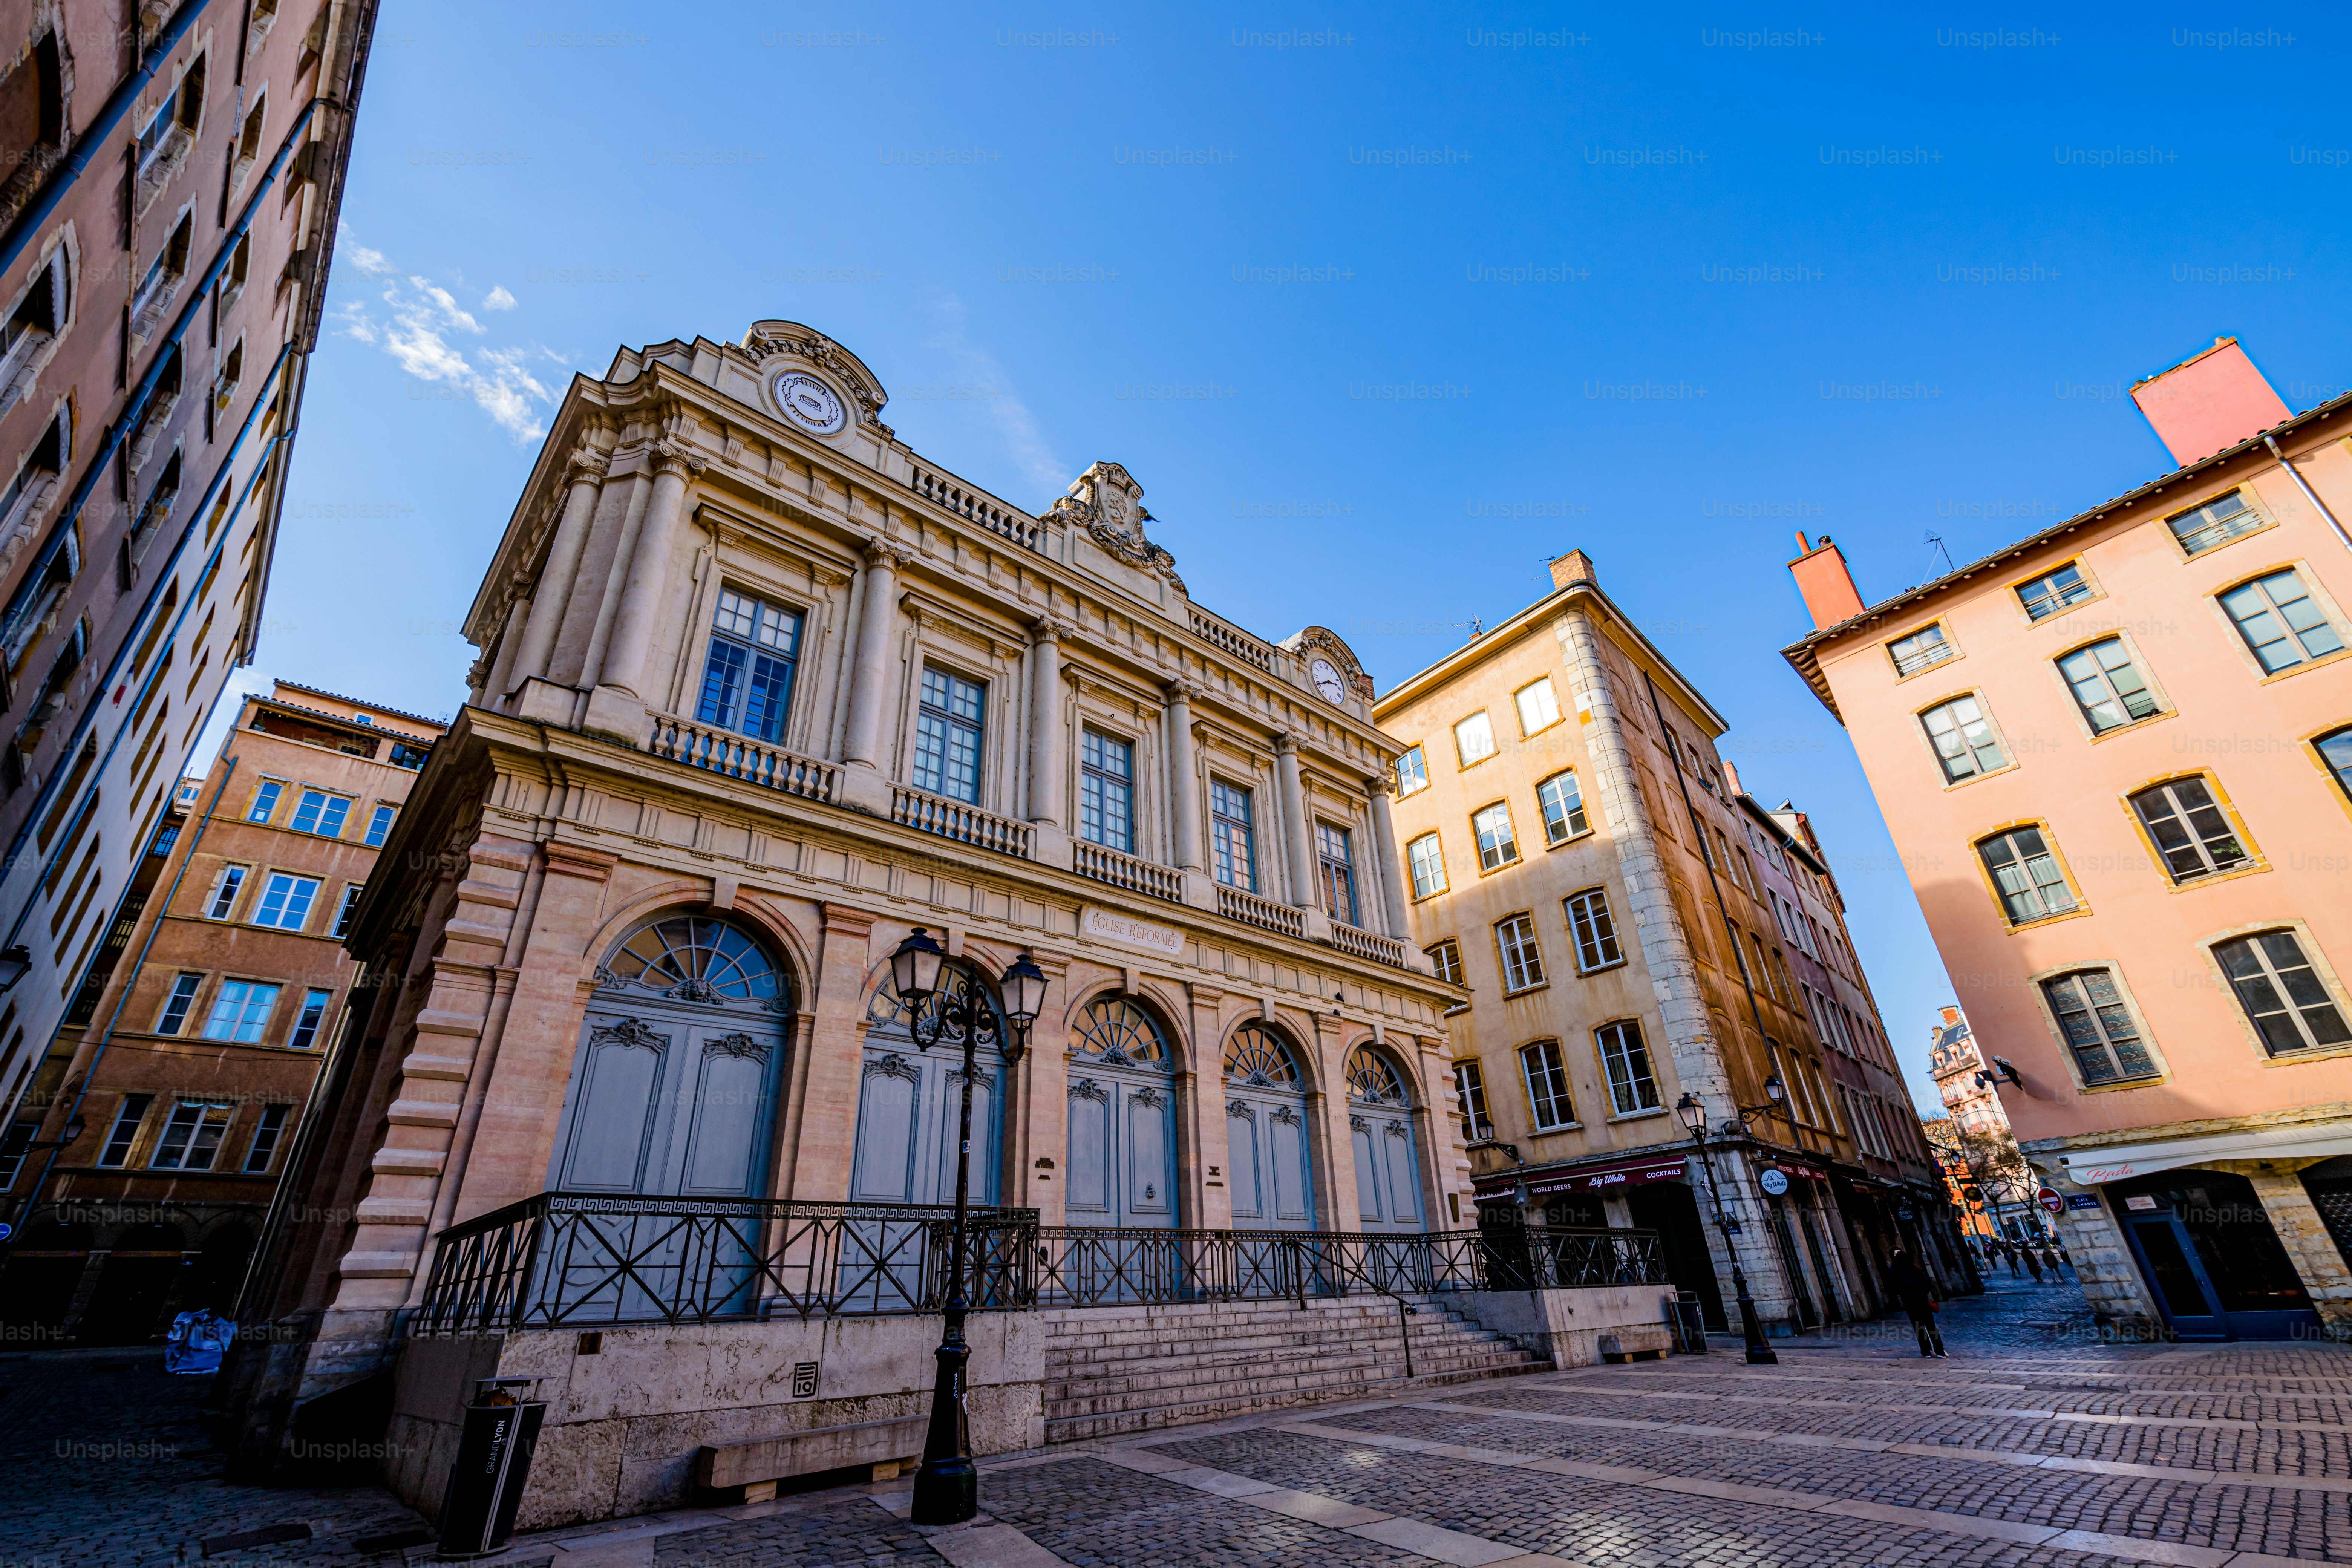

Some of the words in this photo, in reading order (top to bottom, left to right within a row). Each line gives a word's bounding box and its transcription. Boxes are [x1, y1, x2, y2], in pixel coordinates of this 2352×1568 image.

[804, 380, 821, 392] XXVII
[1589, 1177, 1603, 1188] Big
[1604, 1174, 1625, 1184] White
[1646, 1169, 1681, 1179] COCKTAILS
[2087, 1164, 2134, 1183] Basta
